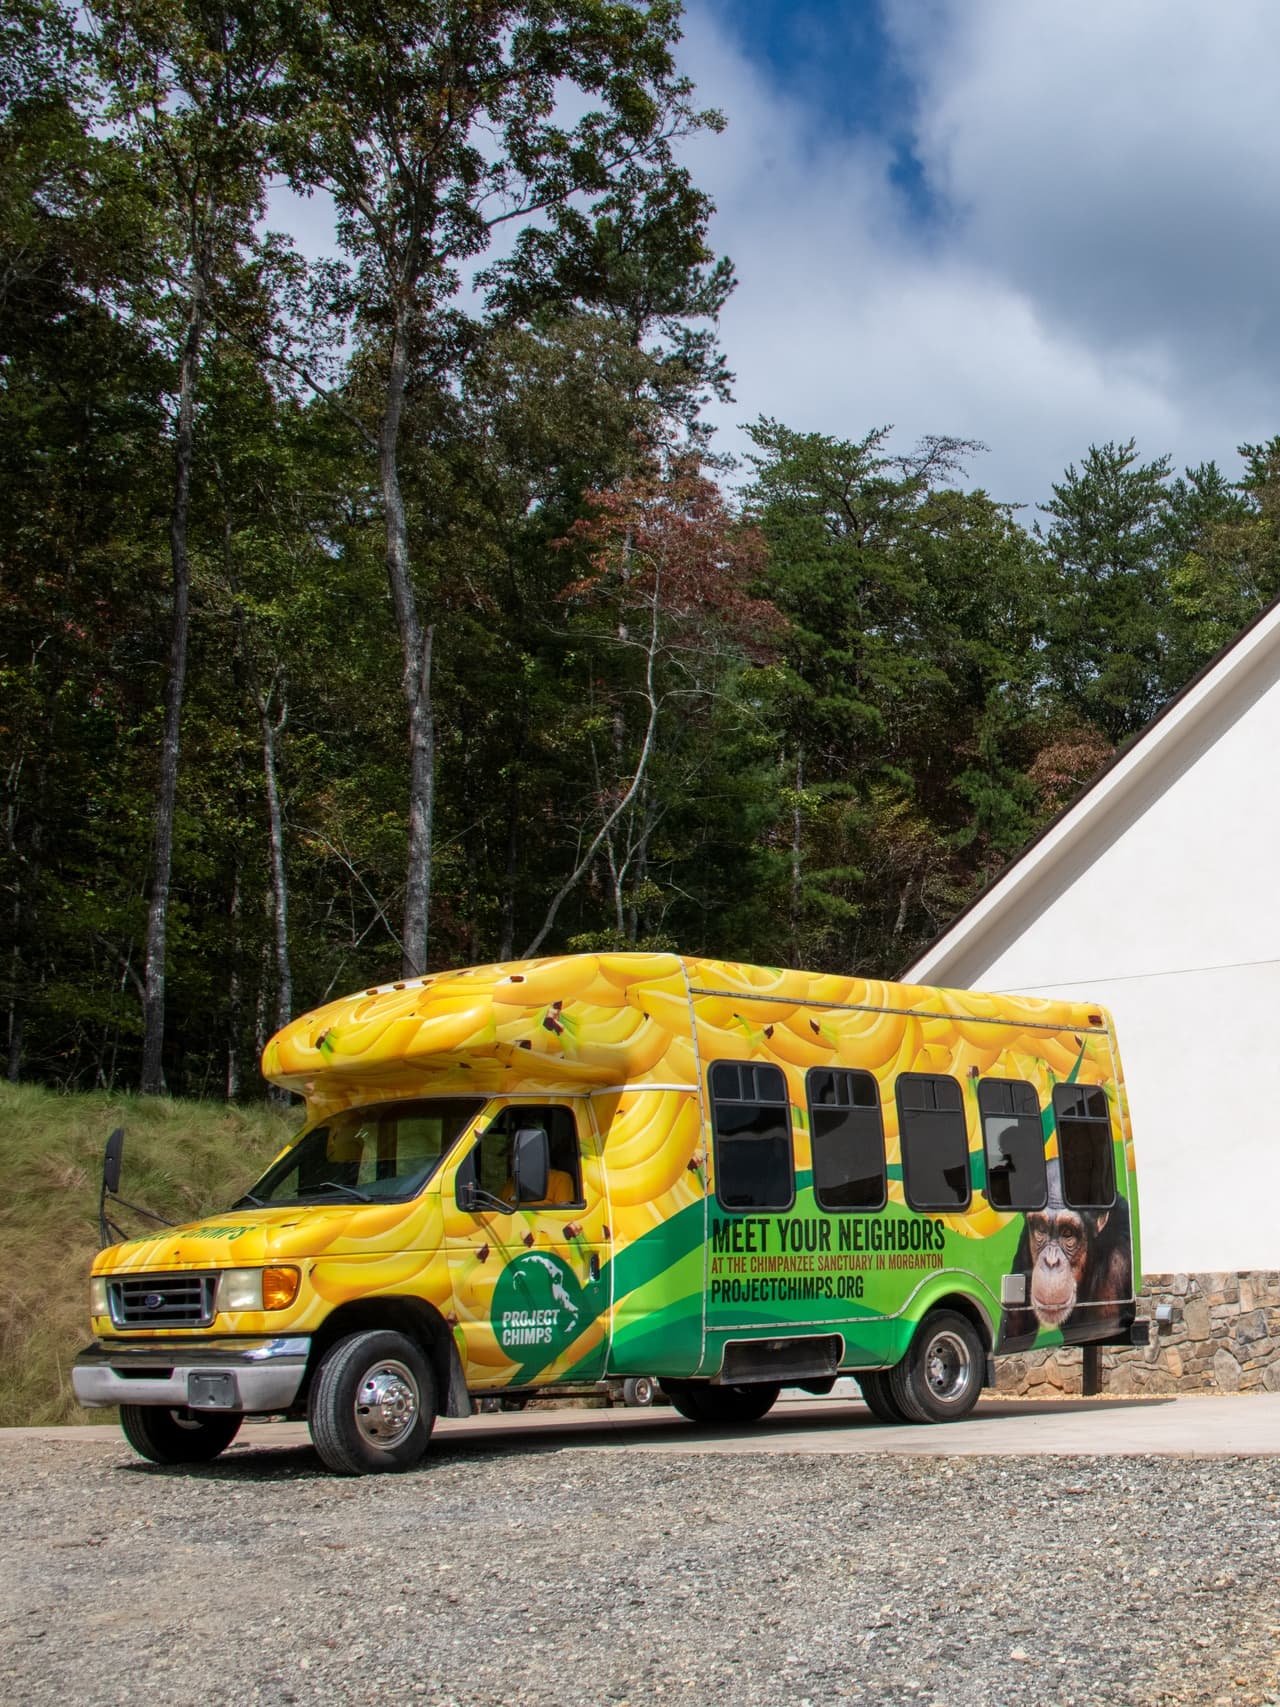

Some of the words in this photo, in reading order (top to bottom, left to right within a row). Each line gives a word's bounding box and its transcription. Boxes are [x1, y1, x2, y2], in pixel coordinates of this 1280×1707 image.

[712, 1218, 770, 1253] MEET
[777, 1218, 831, 1252] YOUR
[839, 1218, 945, 1252] NEIGHBORS
[711, 1256, 724, 1274] AT
[727, 1256, 747, 1273] THE
[750, 1255, 814, 1273] CHIMPANZEE
[817, 1254, 873, 1272] SANCTUARY
[876, 1254, 885, 1270] IN
[888, 1253, 943, 1270] MORGANTON
[711, 1275, 864, 1303] PROJECTCHIMPS.ORG
[502, 1309, 560, 1328] PROJECT
[502, 1327, 553, 1346] CHIMPS
